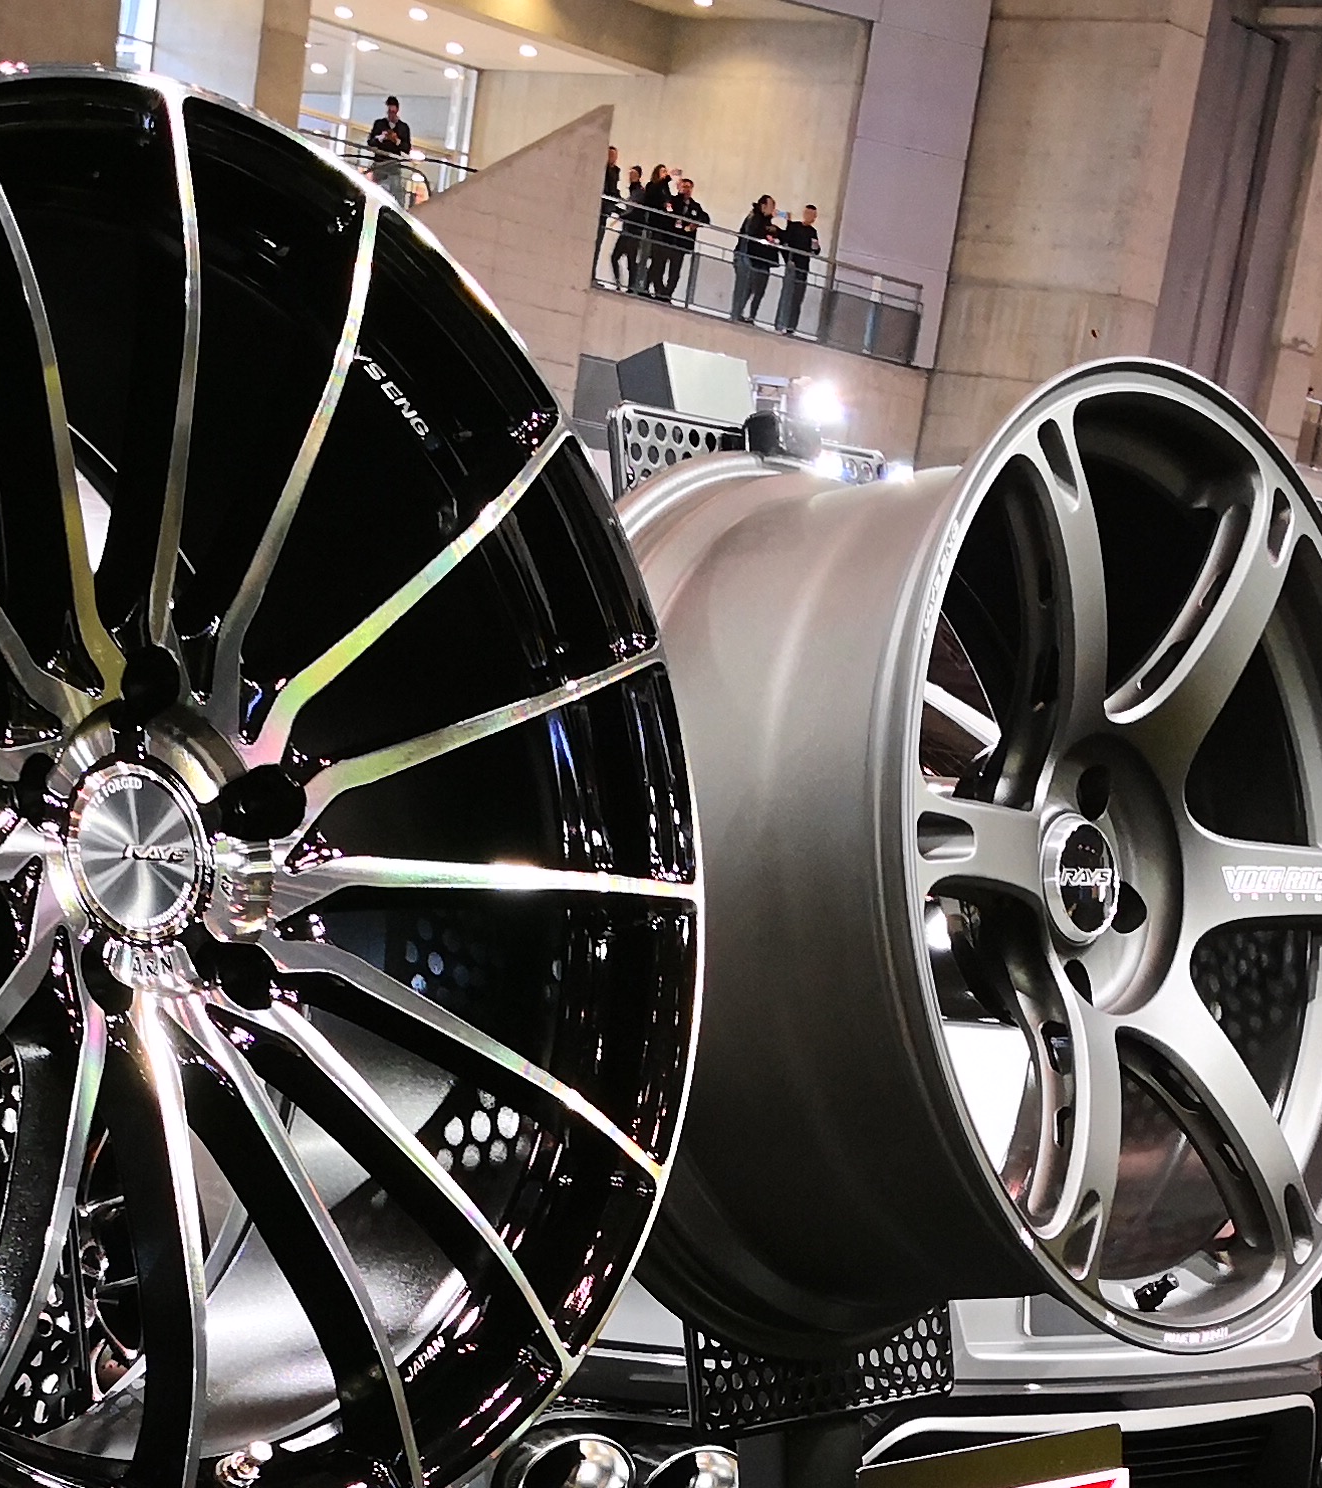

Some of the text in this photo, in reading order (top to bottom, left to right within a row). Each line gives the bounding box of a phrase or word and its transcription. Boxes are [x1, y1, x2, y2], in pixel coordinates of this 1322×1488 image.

[1060, 864, 1113, 887] RAYS
[1221, 865, 1286, 894] VOLK
[404, 1335, 446, 1383] JAPAN
